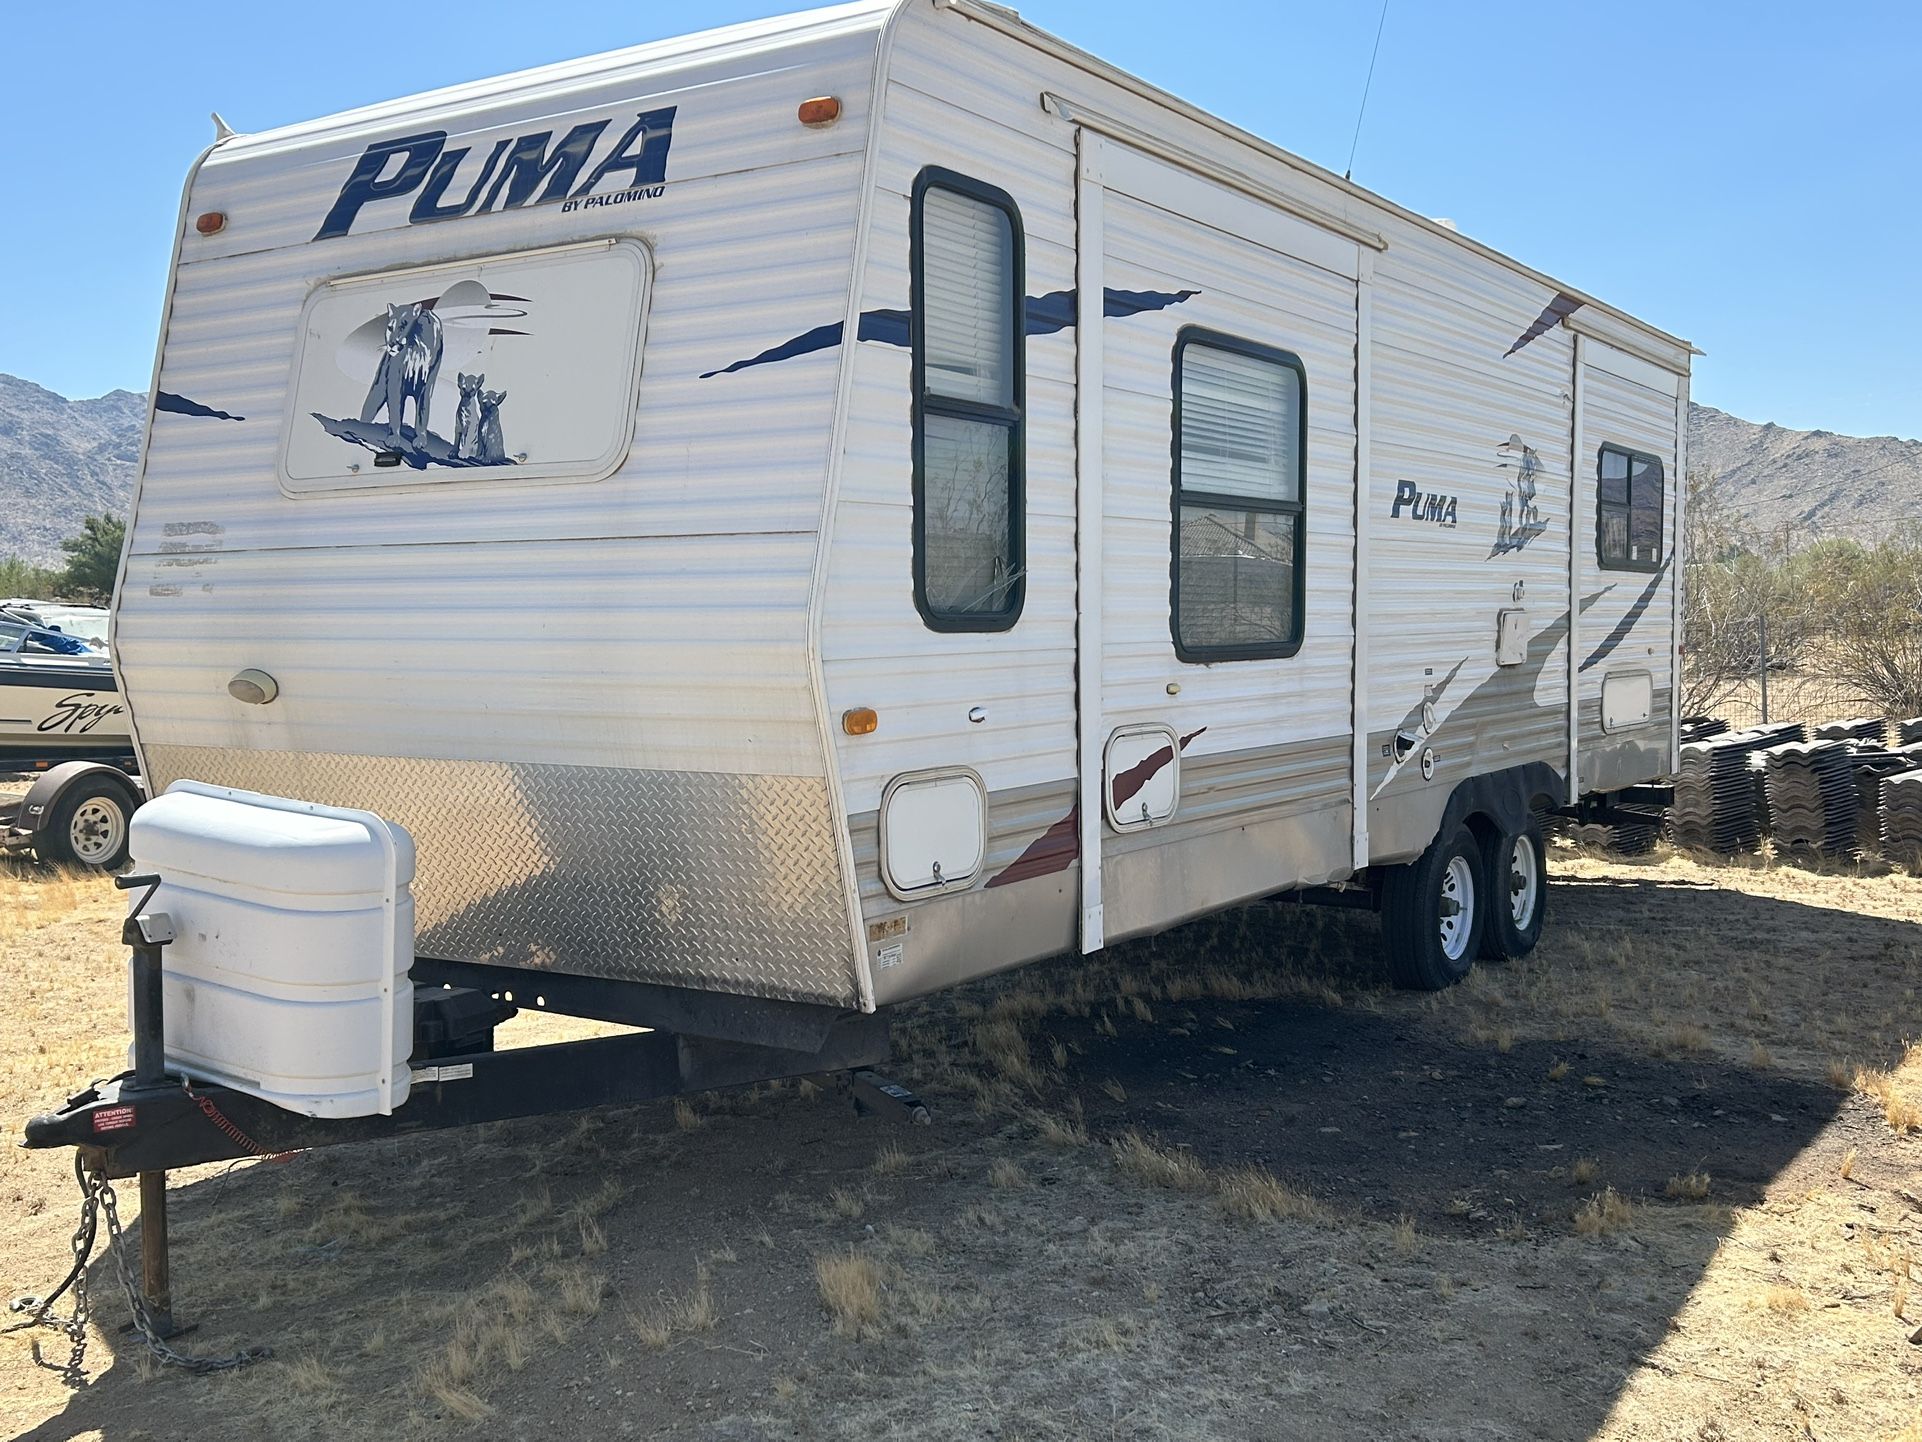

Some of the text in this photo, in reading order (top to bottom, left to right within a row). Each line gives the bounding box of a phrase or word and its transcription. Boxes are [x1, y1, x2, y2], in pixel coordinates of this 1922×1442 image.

[312, 105, 678, 243] PUMA
[561, 186, 666, 213] BY PALOMINO
[1390, 479, 1458, 524] PUMA
